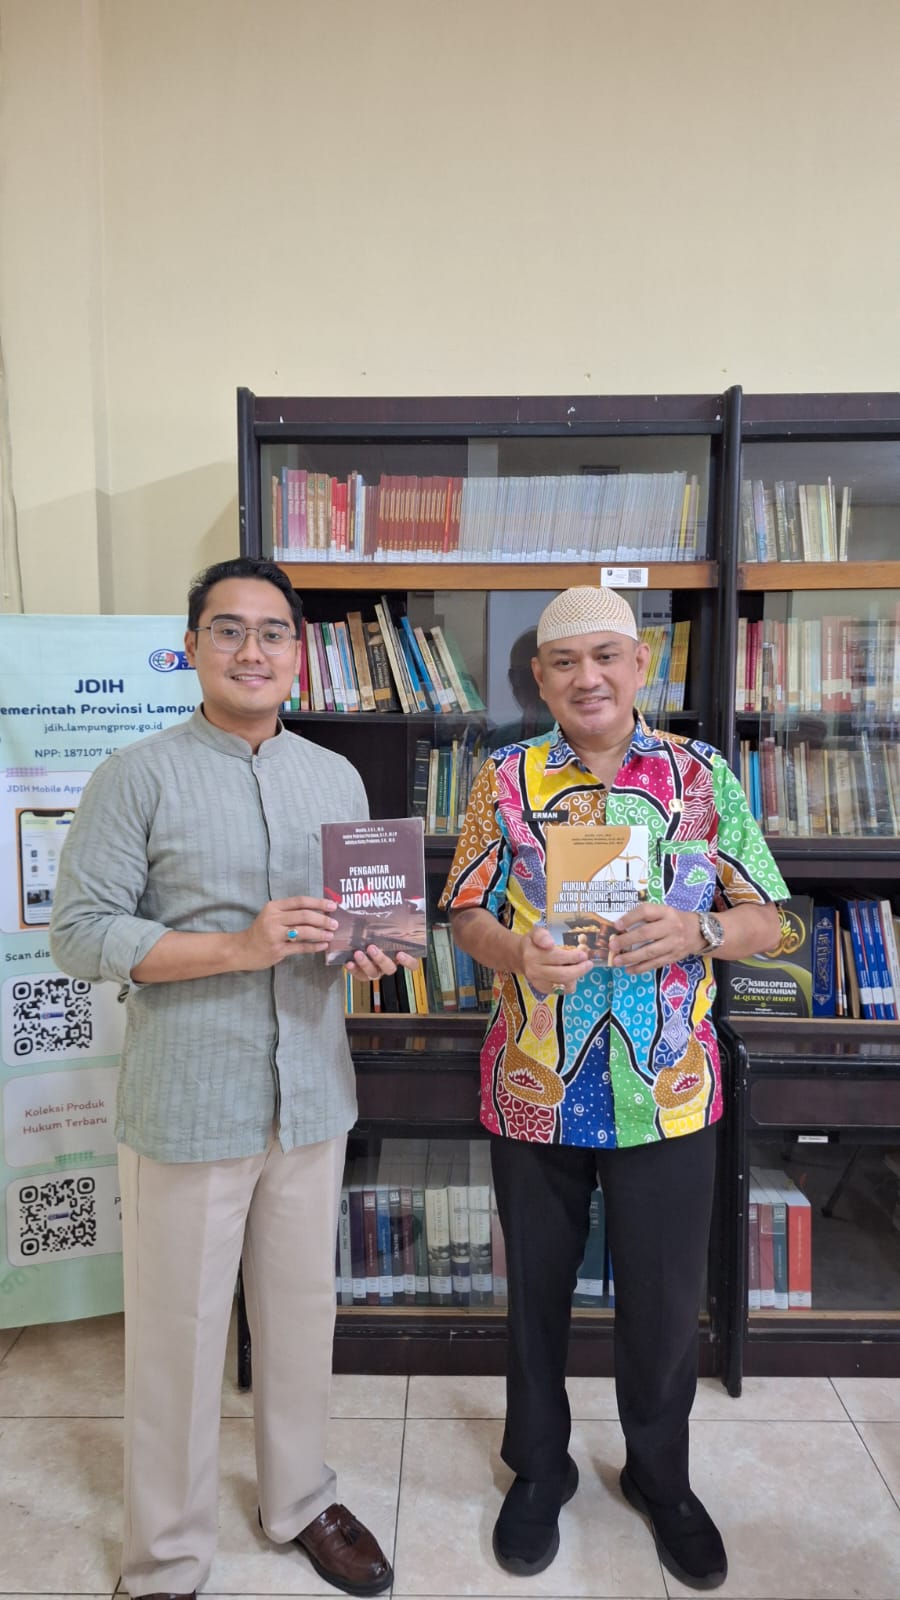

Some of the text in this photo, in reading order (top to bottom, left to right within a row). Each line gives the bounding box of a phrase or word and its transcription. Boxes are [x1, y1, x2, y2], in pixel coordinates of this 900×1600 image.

[74, 679, 124, 693] JDIH
[0, 703, 196, 715] emerintah Provinsi Lampu
[44, 722, 163, 734] jdih.lampungprov.go.id
[34, 749, 61, 758] NPP:
[64, 748, 102, 757] 187107
[32, 785, 61, 793] Mobile
[349, 864, 390, 876] PENGANTAR
[340, 875, 406, 893] TATA HUKUM
[562, 881, 587, 891] HUKUM
[342, 890, 403, 909] INDONESIA
[559, 892, 579, 902] KITAB
[553, 903, 579, 912] HUKUM
[5, 952, 32, 961] Scan
[747, 987, 797, 995] PENGETAHUAN
[25, 1099, 105, 1118] Koleksi Produk
[23, 1117, 107, 1135] Hukum Terbaru
